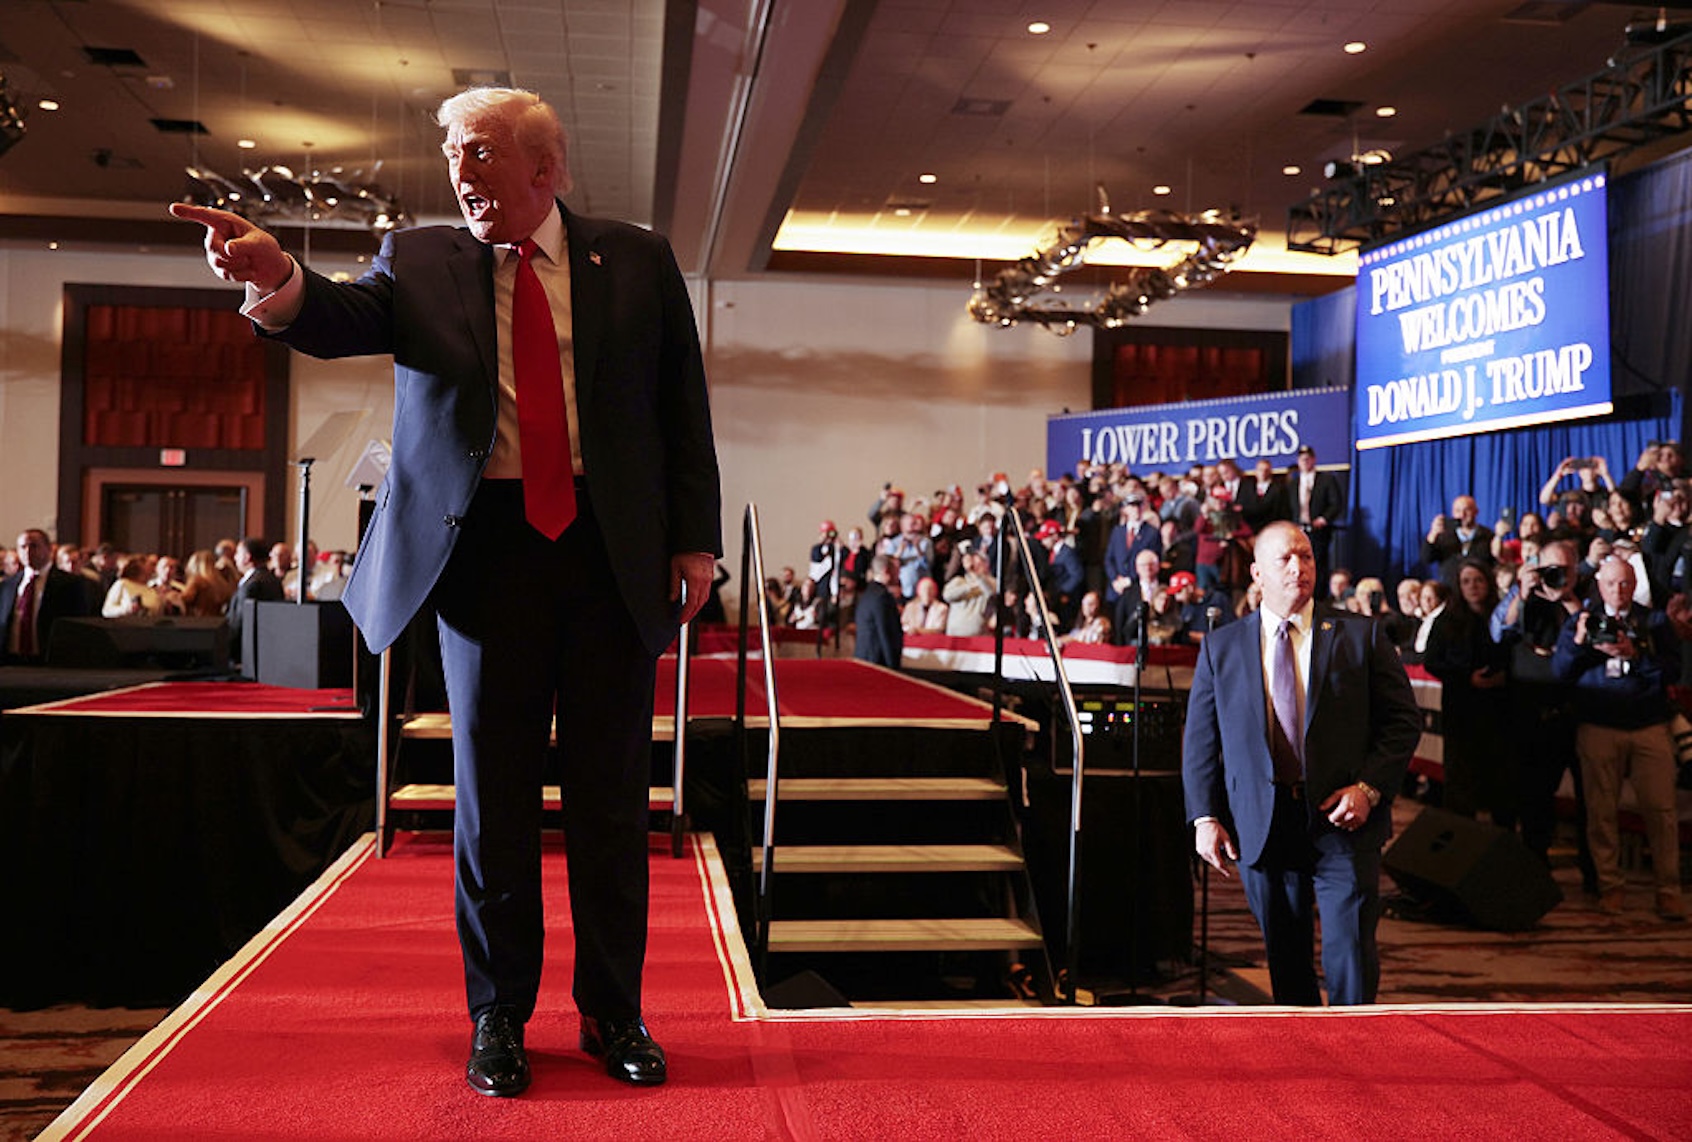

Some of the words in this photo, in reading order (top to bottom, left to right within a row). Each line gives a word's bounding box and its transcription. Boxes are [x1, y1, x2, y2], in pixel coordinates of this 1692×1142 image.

[1370, 207, 1585, 316] PENNSYLVANIA
[1398, 276, 1546, 354] WELCOMES
[1367, 369, 1462, 427] DONALD
[1463, 365, 1484, 420] J.
[1486, 343, 1593, 405] TRUMP
[1082, 421, 1180, 467] LOWER
[1186, 409, 1300, 461] PRICES
